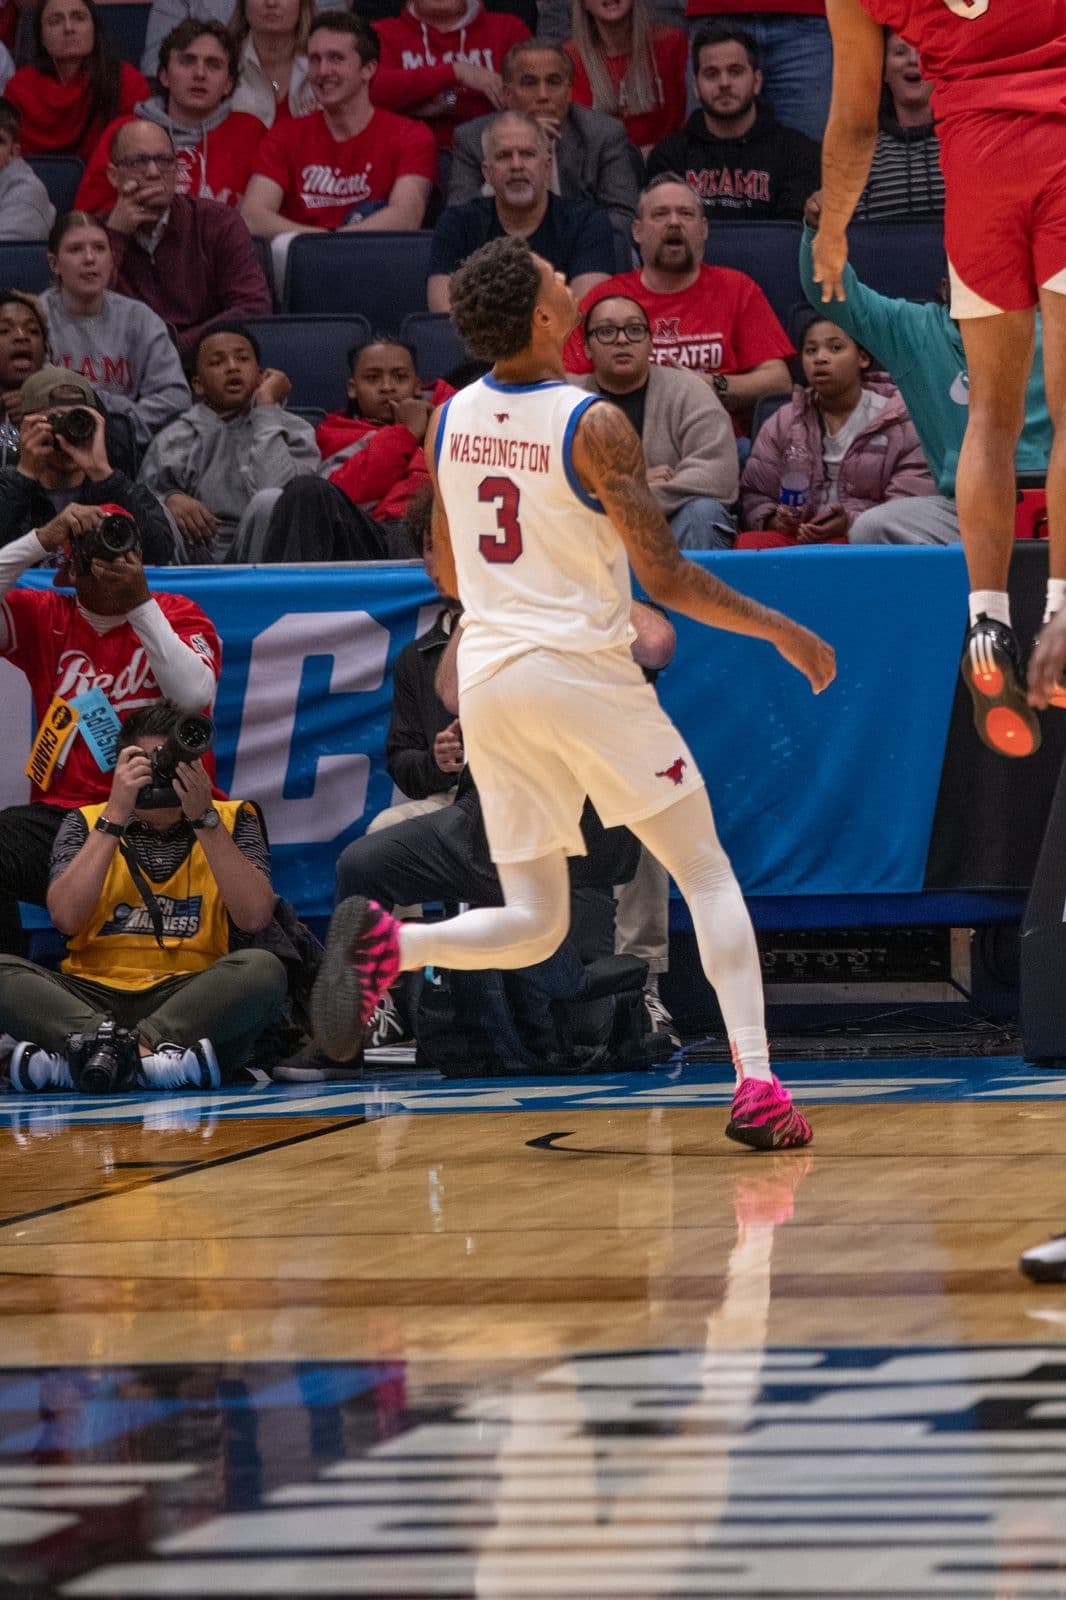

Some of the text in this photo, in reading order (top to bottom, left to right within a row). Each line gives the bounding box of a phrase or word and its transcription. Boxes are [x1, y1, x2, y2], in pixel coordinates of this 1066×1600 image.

[301, 162, 372, 197] Miami
[686, 163, 771, 201] MIAMI
[450, 432, 551, 474] WASHINGTON
[477, 476, 524, 564] 3
